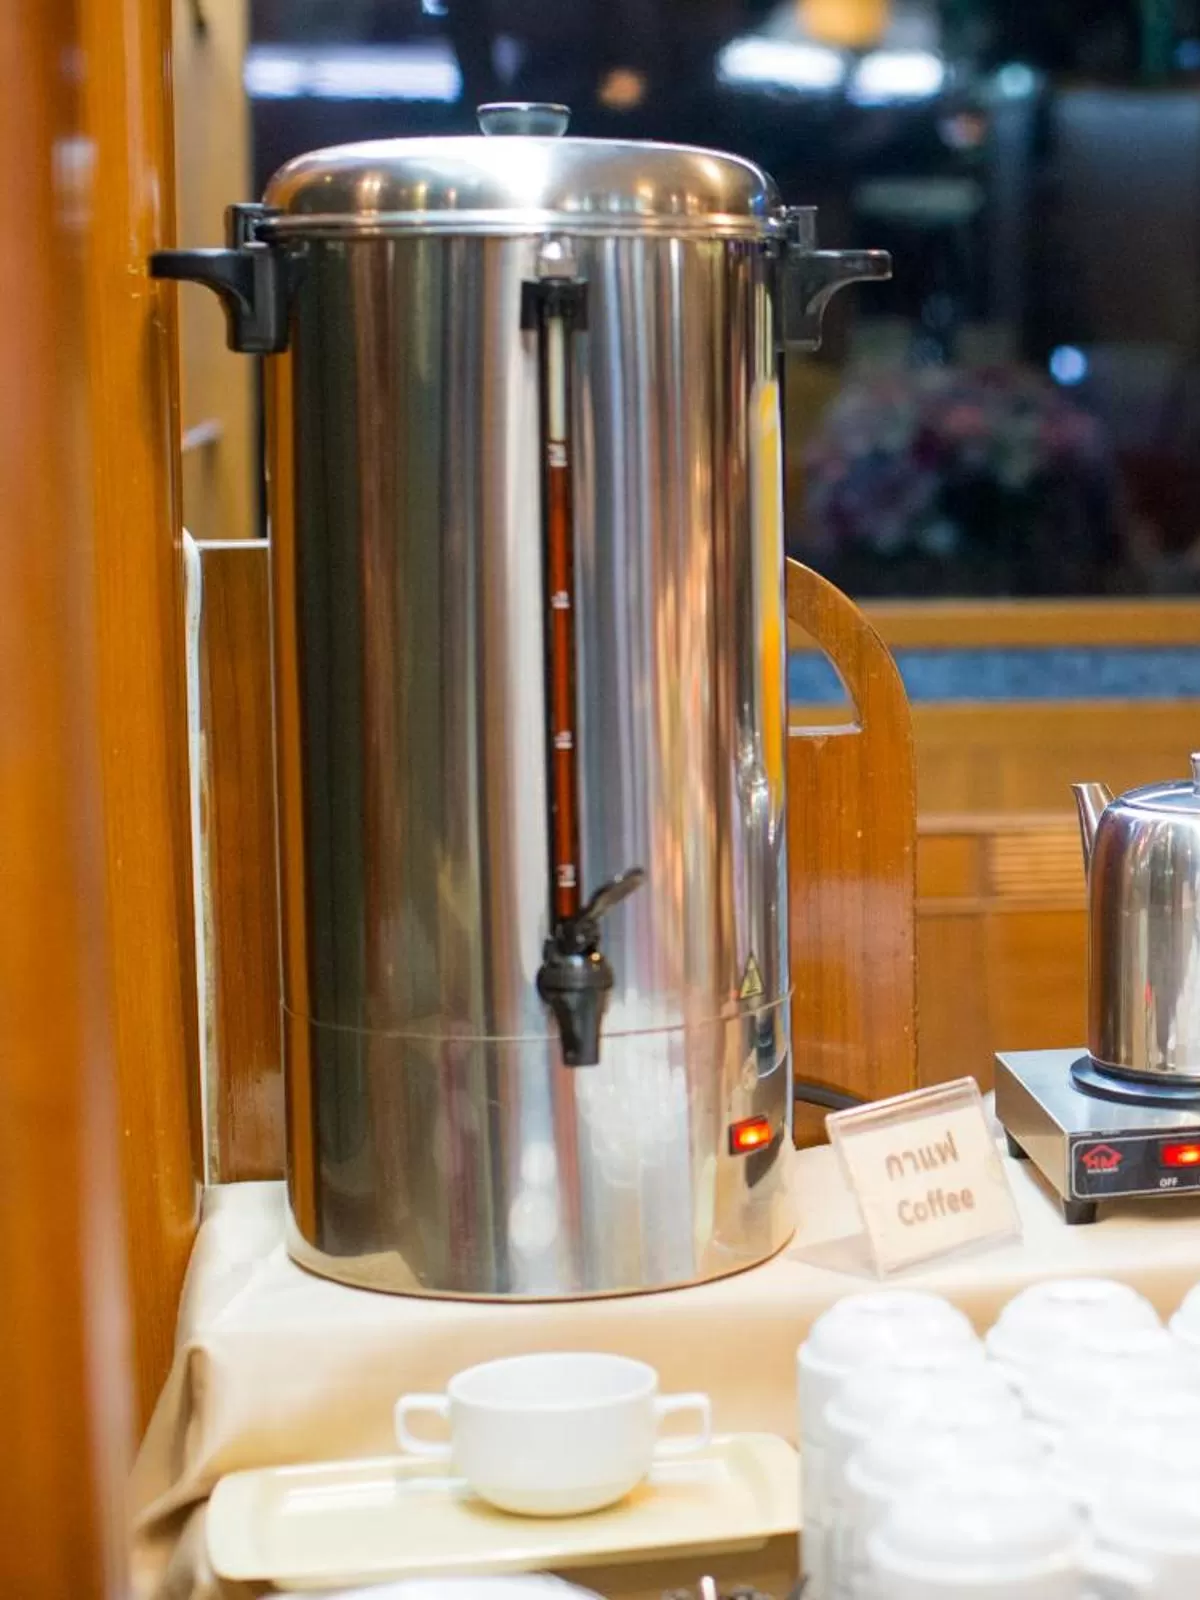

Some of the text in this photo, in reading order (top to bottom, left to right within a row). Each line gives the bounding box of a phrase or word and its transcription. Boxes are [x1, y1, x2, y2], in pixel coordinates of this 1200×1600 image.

[884, 1130, 959, 1181] กาแฟ
[1159, 1176, 1179, 1188] OFF
[897, 1187, 976, 1227] Coffee
